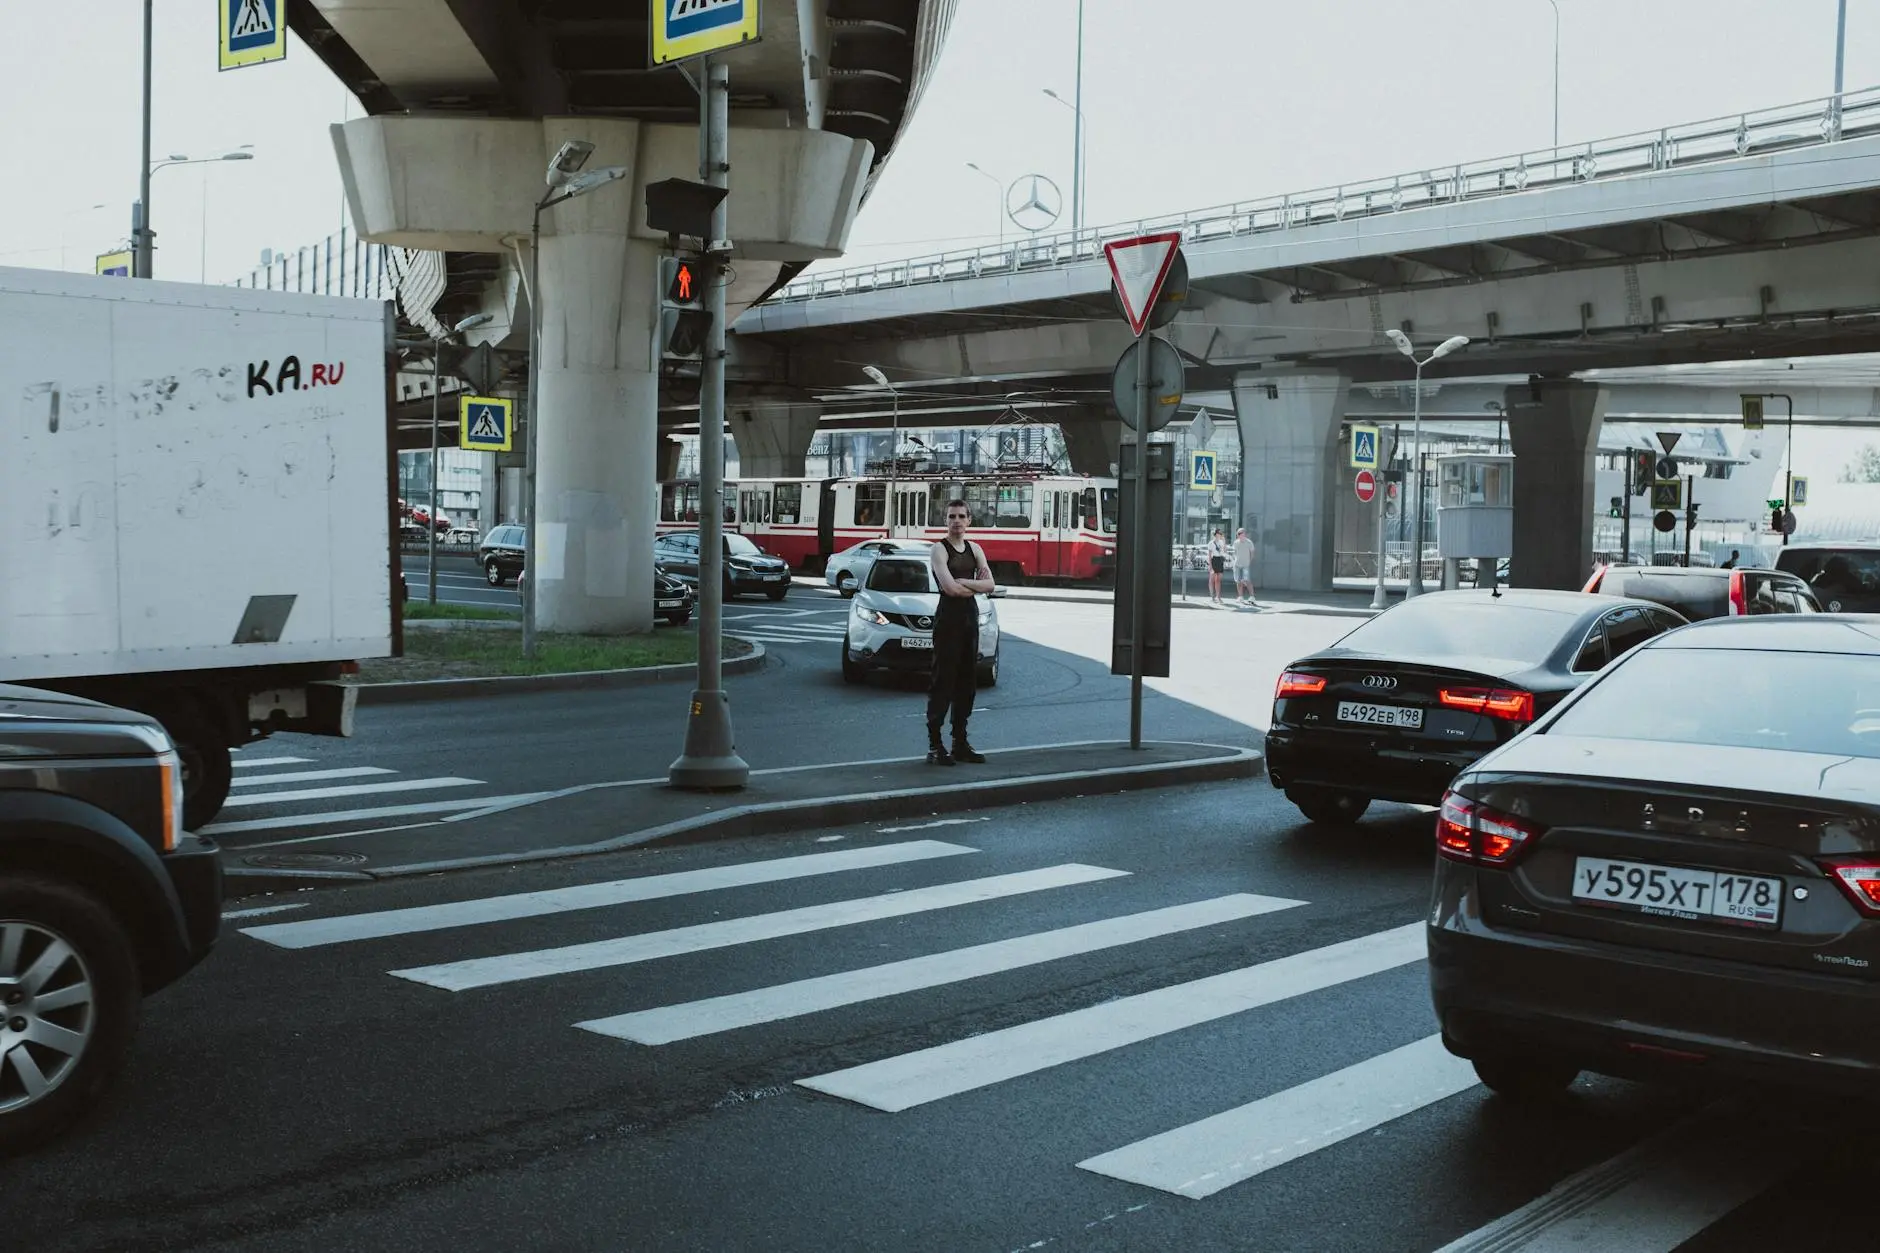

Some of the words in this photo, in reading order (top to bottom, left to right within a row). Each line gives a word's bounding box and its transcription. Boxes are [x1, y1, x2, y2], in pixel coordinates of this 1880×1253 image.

[1398, 708, 1419, 722] 198
[1586, 864, 1710, 908] У595ХТ
[1720, 876, 1771, 907] 178
[1728, 904, 1755, 917] RUS
